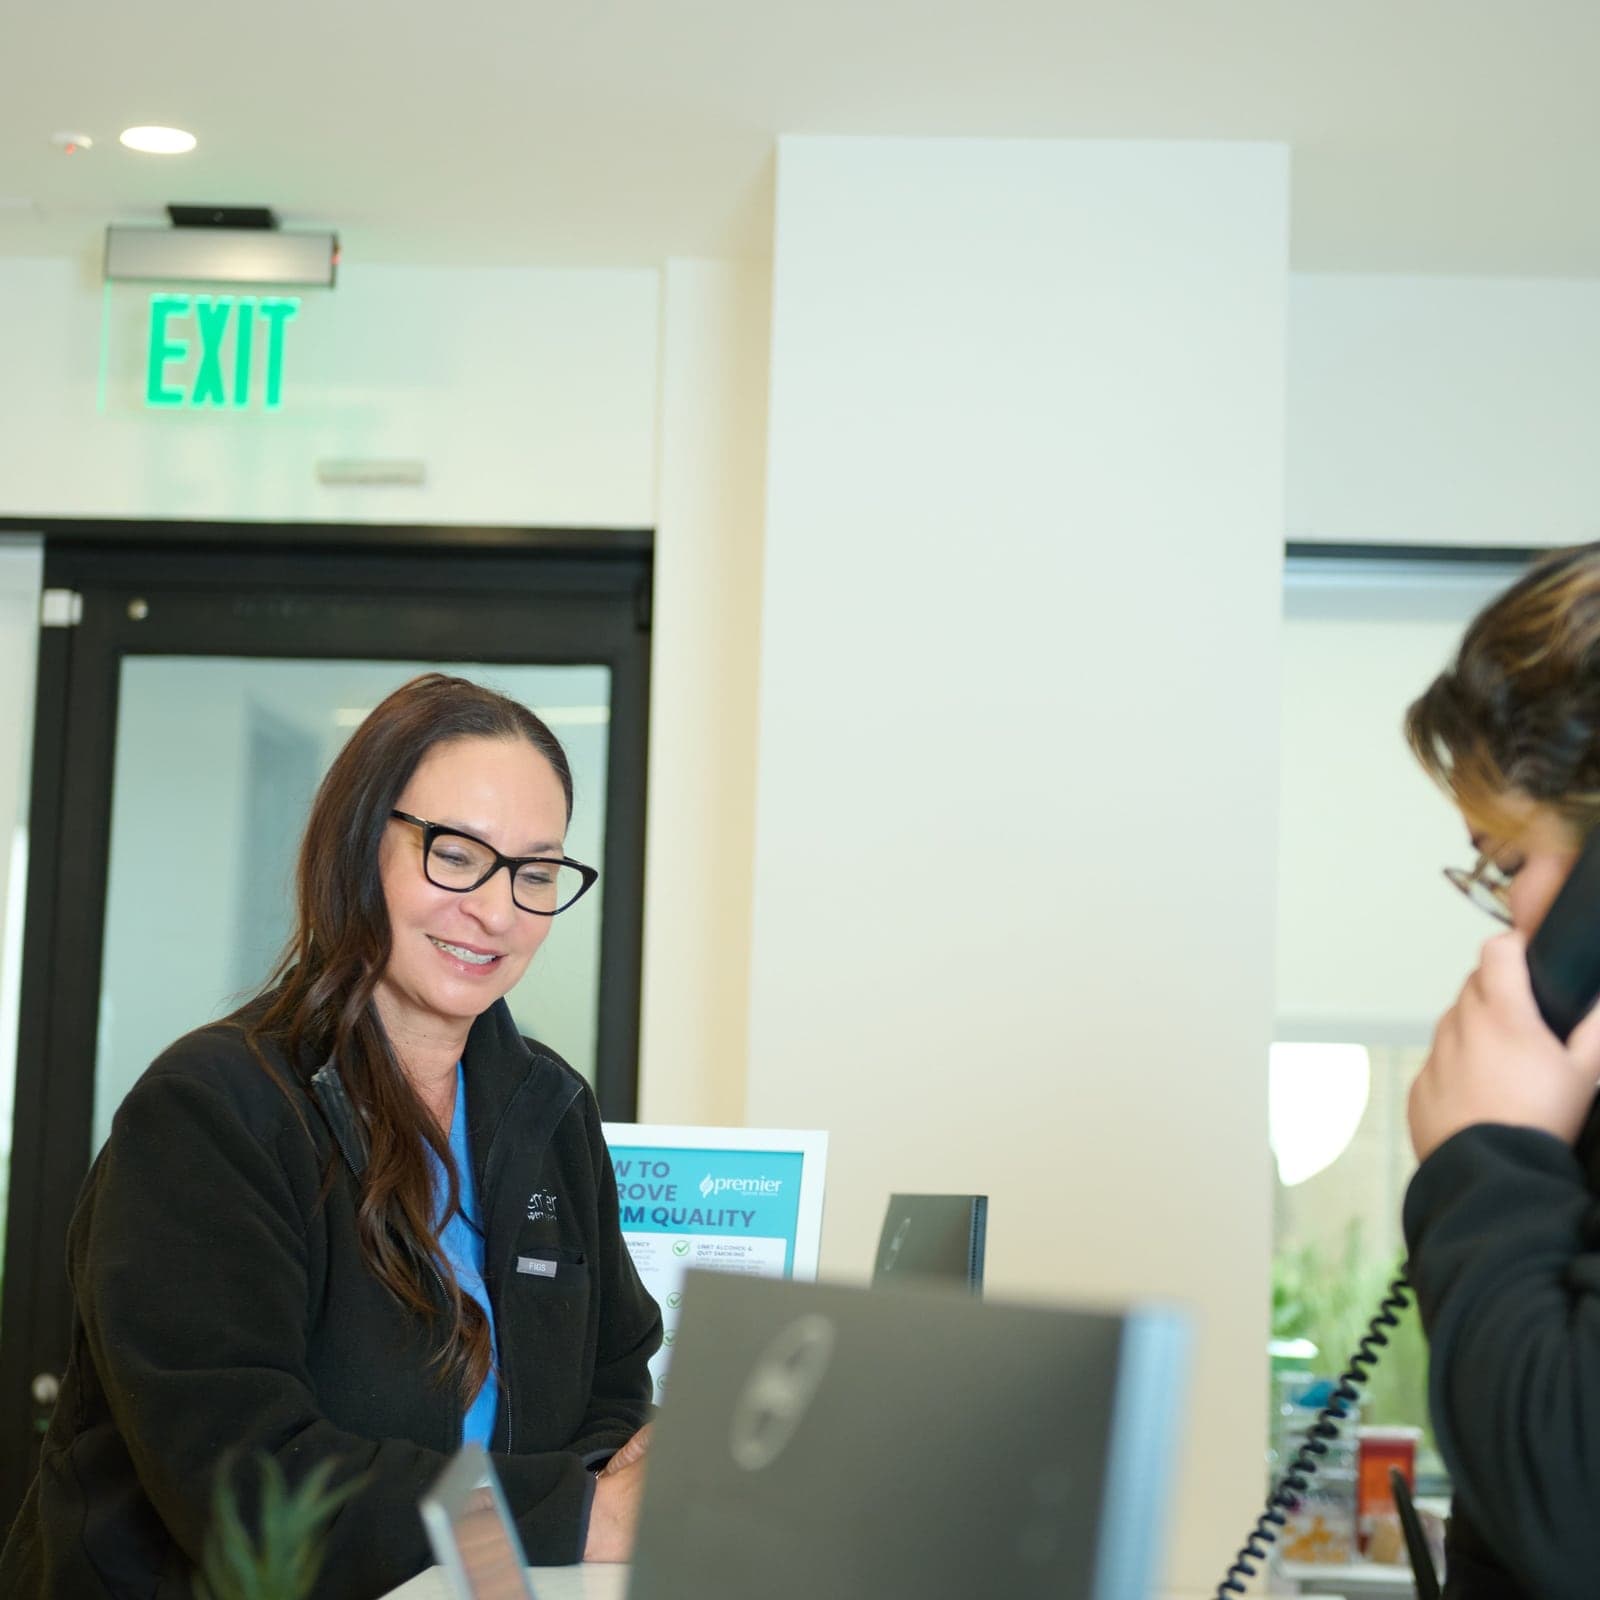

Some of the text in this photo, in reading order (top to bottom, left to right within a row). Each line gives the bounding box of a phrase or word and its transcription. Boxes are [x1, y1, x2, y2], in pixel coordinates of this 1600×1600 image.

[146, 293, 300, 411] EXIT
[638, 1160, 671, 1178] TO
[713, 1175, 783, 1195] premier
[651, 1206, 756, 1228] QUALITY
[528, 1261, 546, 1272] FIGS
